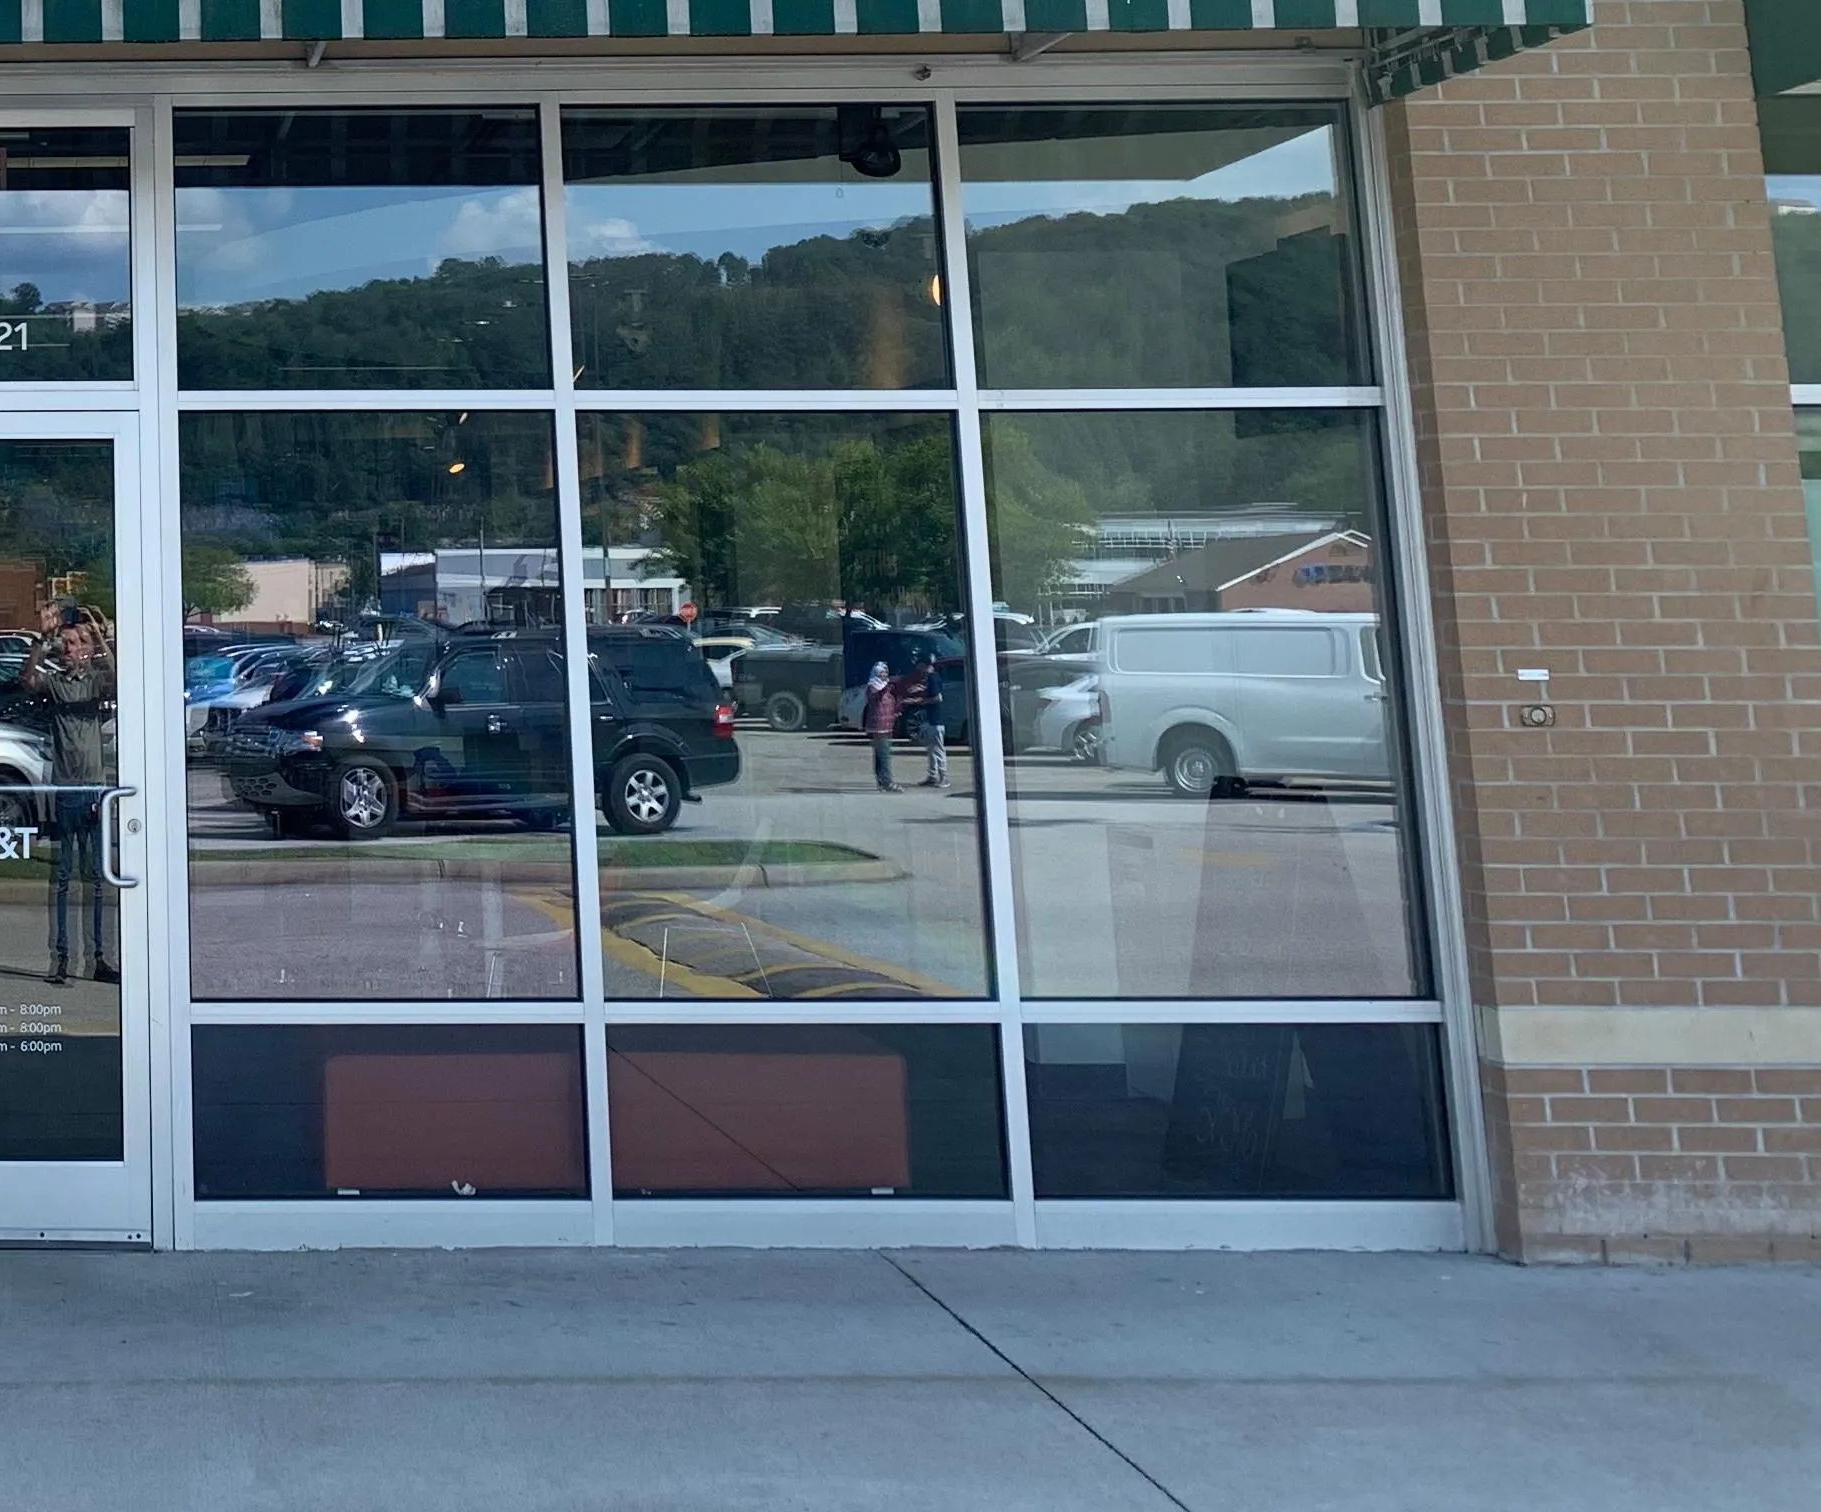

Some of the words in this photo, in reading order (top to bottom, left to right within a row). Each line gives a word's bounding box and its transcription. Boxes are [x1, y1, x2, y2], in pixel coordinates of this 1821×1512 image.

[19, 1004, 62, 1017] 8:00pm
[19, 1022, 62, 1035] 8:00pm
[20, 1040, 63, 1054] 6:00pm
